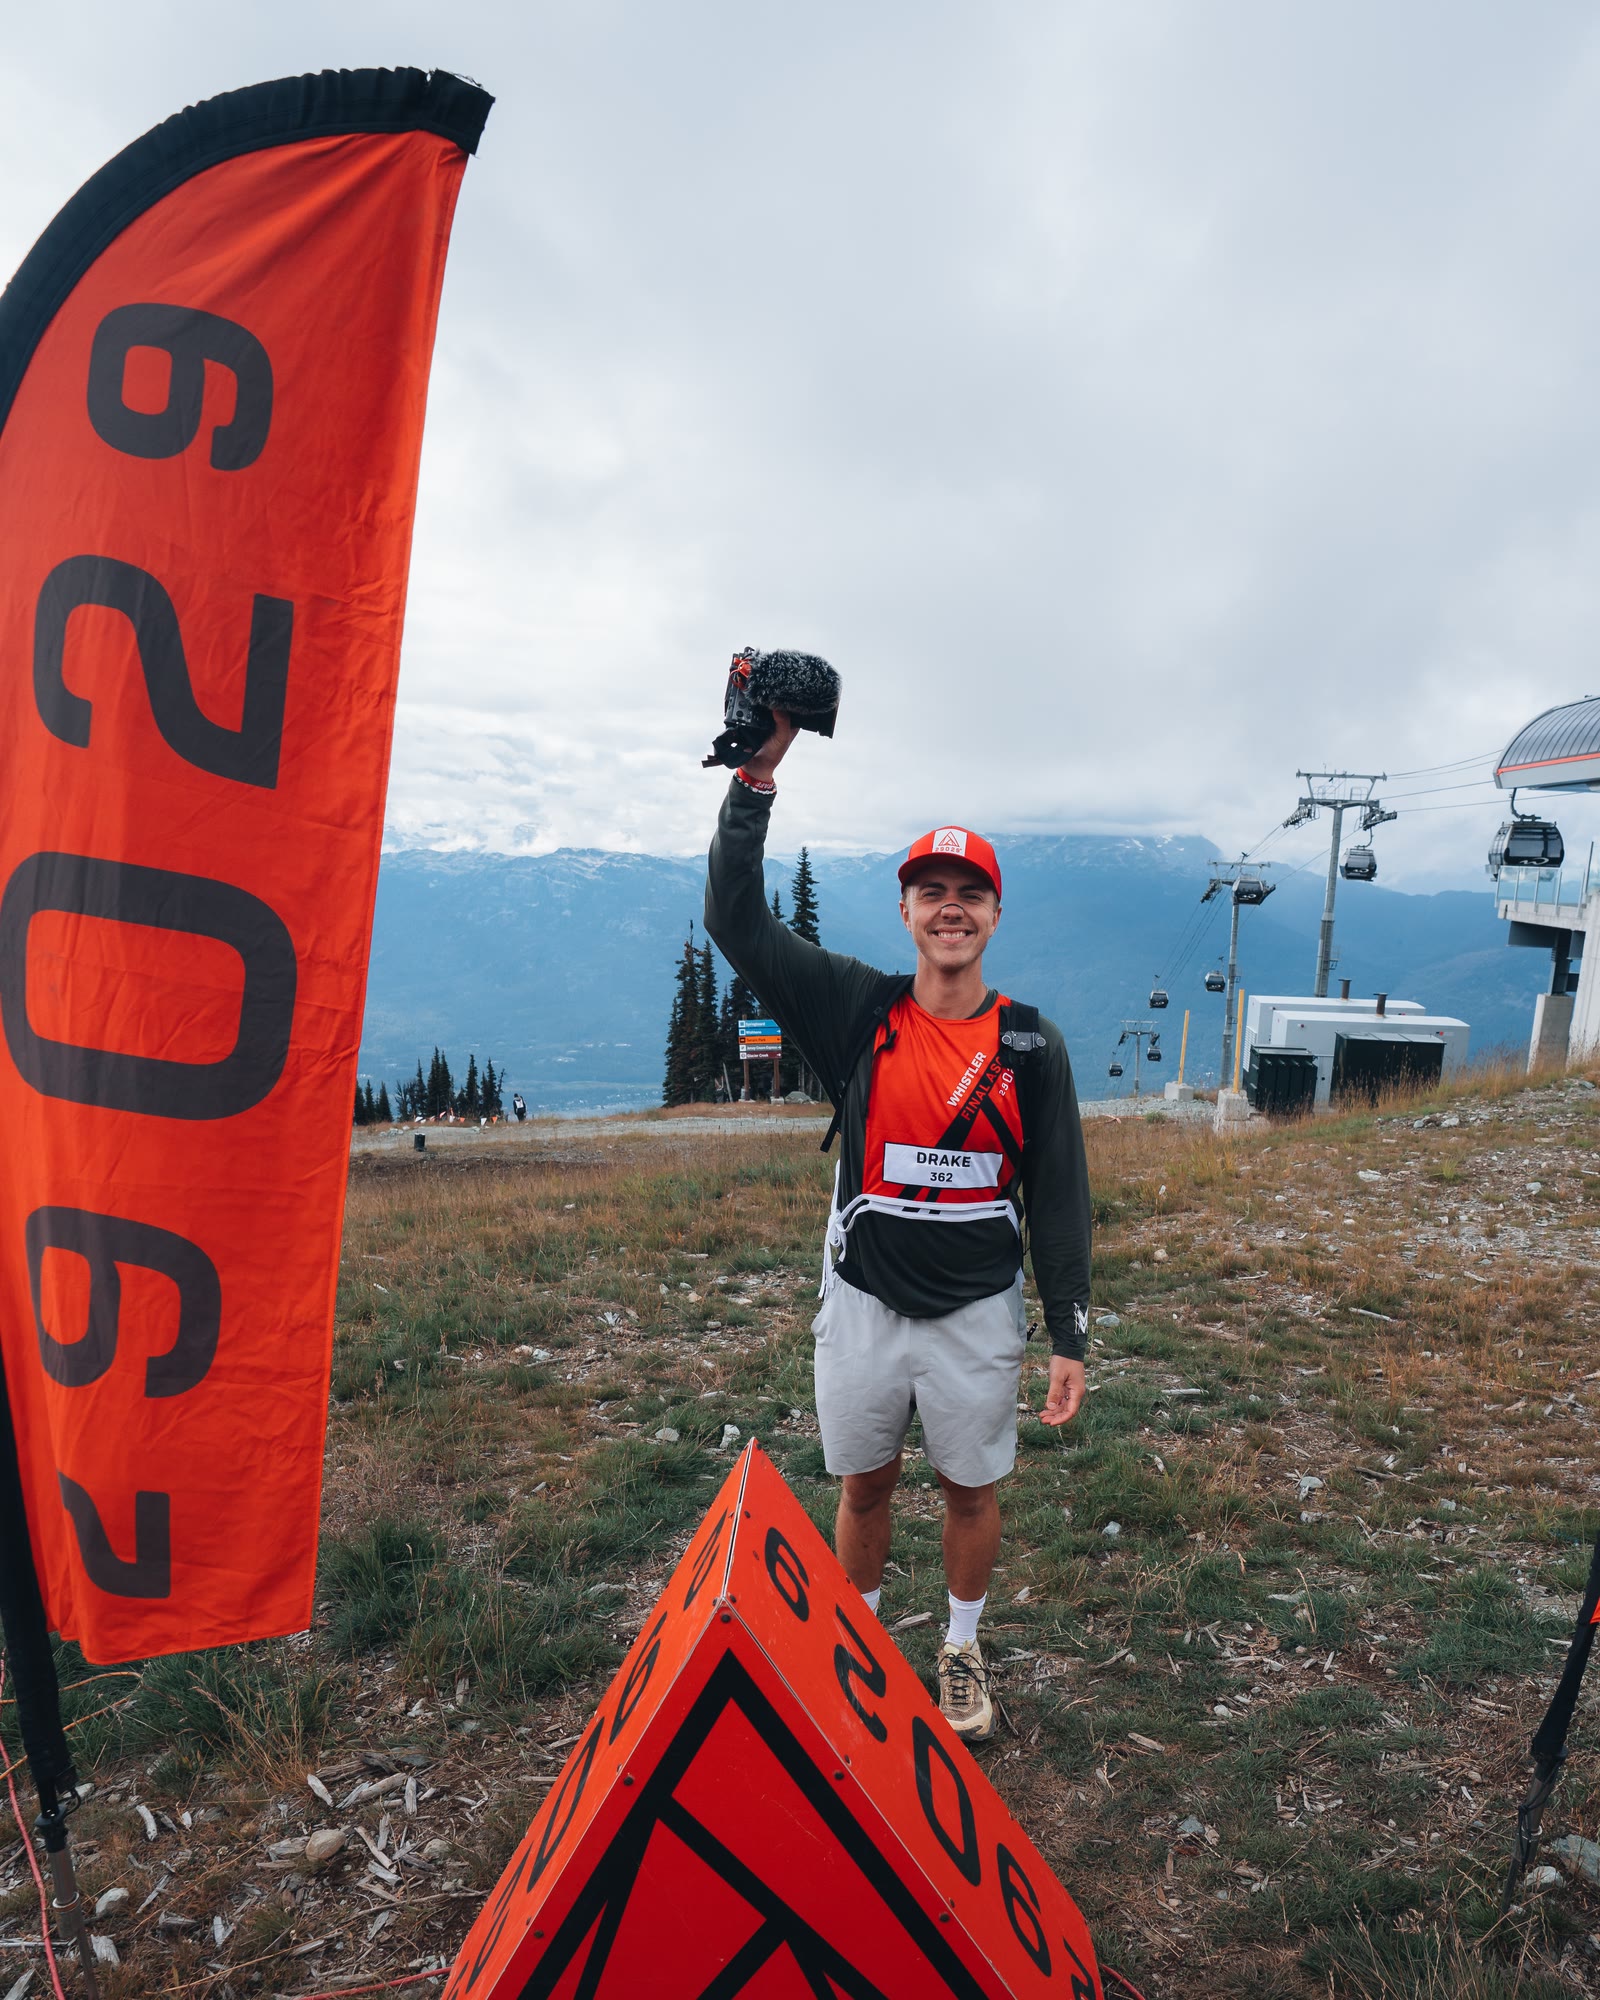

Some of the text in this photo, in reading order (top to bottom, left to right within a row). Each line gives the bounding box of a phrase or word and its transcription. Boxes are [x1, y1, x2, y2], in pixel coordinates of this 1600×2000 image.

[946, 1051, 987, 1107] WHISTLER
[960, 1084, 991, 1121] FINAL
[916, 1151, 972, 1168] DRAKE
[929, 1171, 953, 1183] 362
